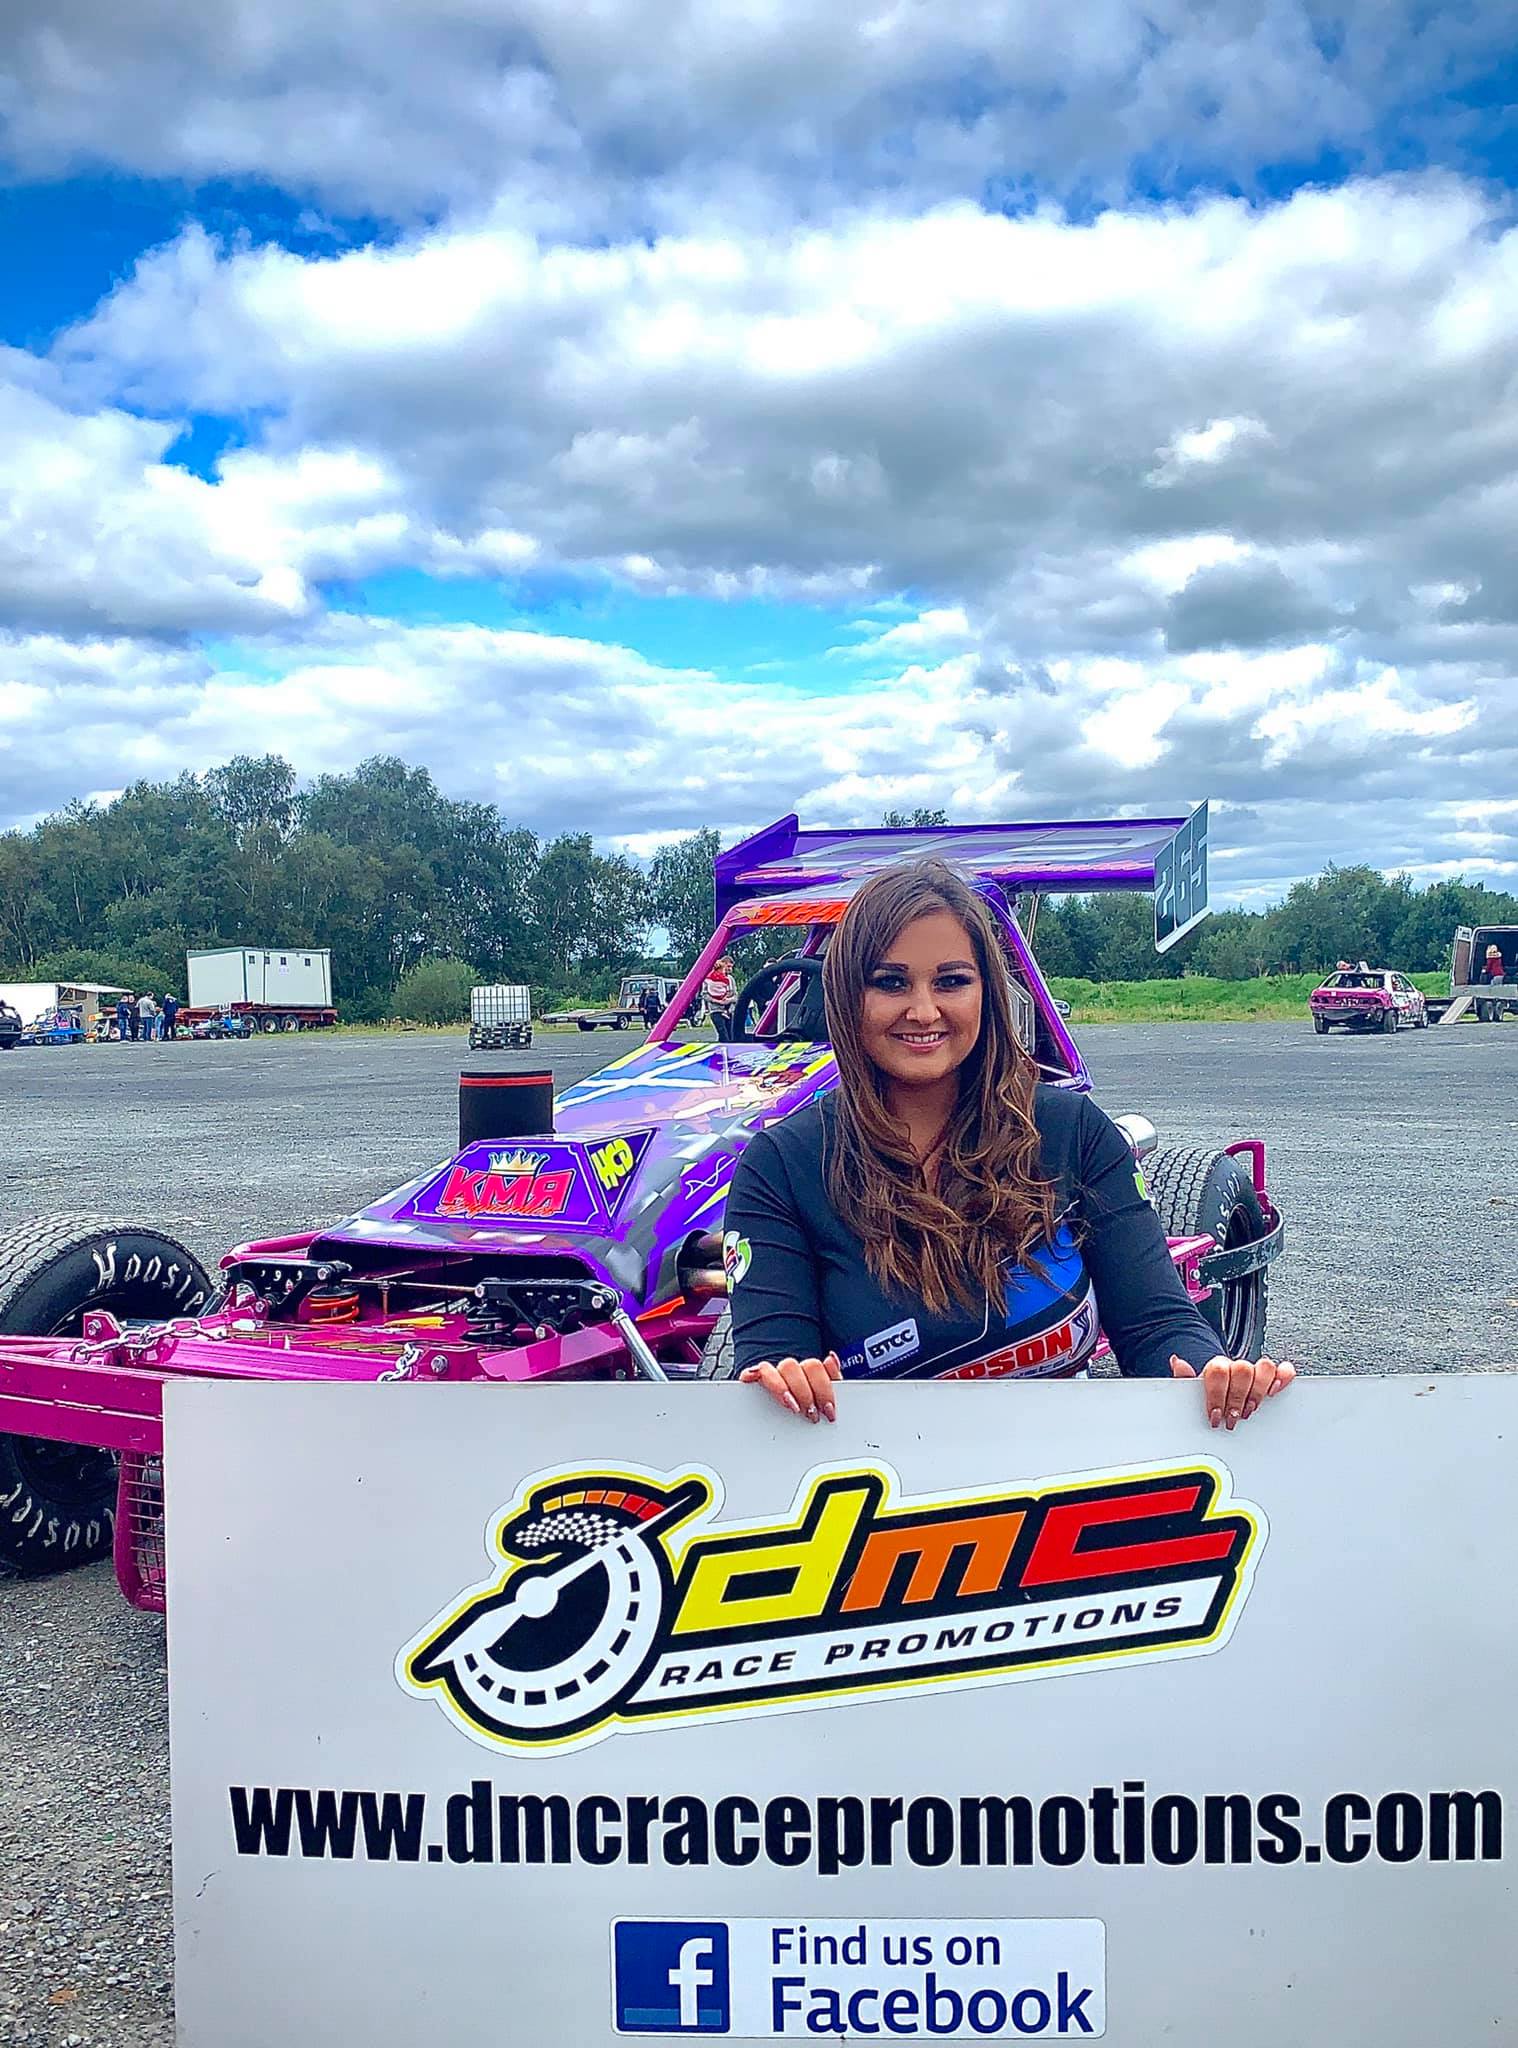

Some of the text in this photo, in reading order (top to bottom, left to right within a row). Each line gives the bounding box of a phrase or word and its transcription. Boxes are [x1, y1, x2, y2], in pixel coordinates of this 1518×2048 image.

[1154, 802, 1208, 943] 265
[867, 1328, 915, 1360] BTCC
[942, 1324, 1073, 1379] PSON
[671, 1486, 1238, 1635] dmc
[660, 1596, 1183, 1687] RACE PROMOTIONS
[228, 1780, 1503, 1876] www.dmcracepromotions.com
[771, 1926, 1001, 1966] Find us on
[771, 1972, 1095, 2034] Facebook
